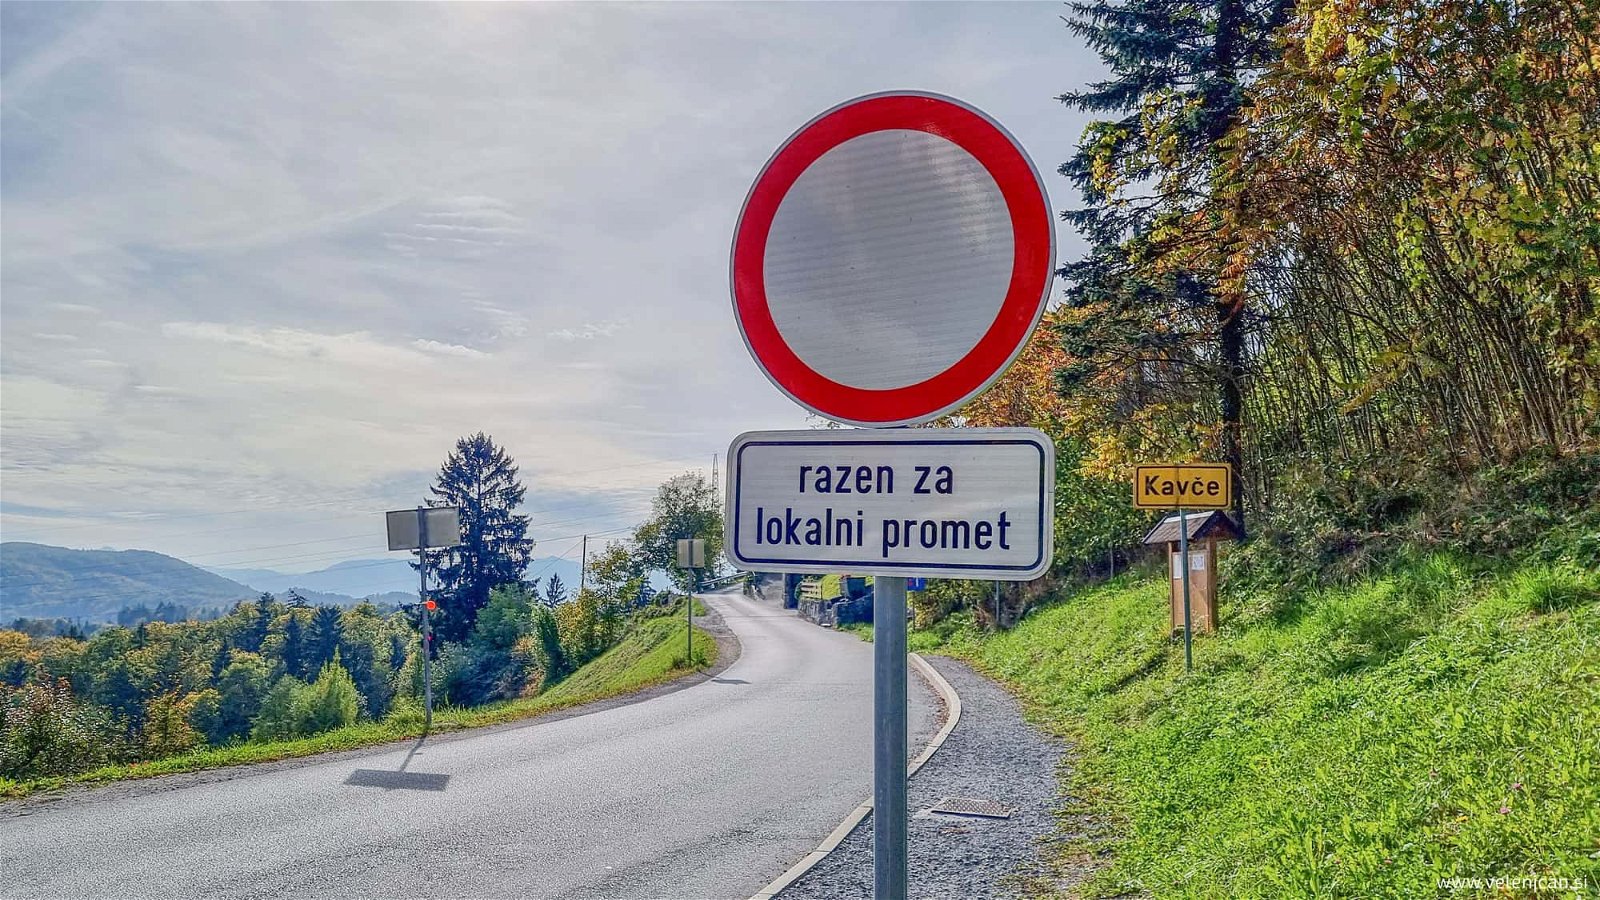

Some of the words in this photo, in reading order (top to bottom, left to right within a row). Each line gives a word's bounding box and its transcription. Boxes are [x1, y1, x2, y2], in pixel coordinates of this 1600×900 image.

[799, 465, 894, 494] razen
[913, 465, 953, 494] za
[1144, 475, 1220, 496] Kavče
[756, 507, 863, 547] lokalni
[882, 511, 1011, 558] promet
